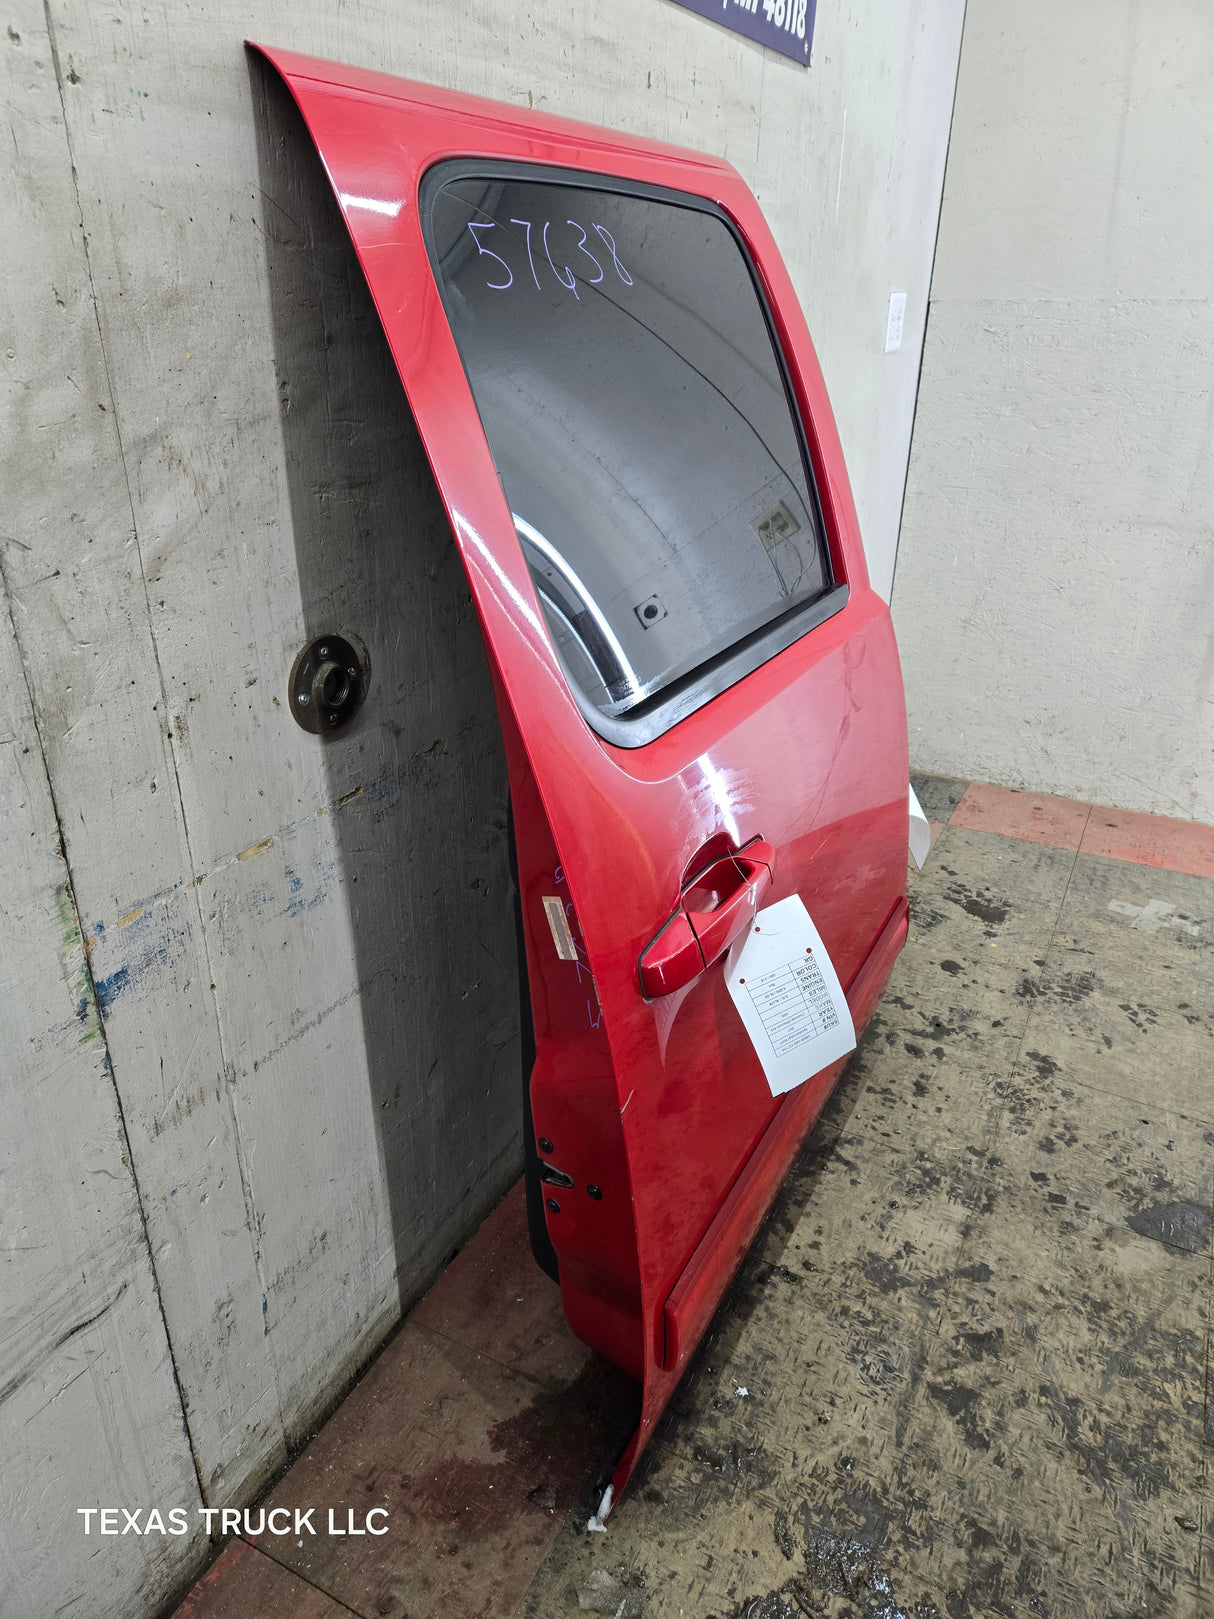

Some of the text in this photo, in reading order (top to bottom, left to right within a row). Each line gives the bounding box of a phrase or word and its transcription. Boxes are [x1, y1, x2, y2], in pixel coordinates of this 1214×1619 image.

[762, 0, 808, 39] 48118
[467, 218, 634, 300] 57638
[795, 962, 816, 976] COLOR
[799, 970, 819, 983] TRANS
[800, 976, 822, 991] ENGINE
[808, 984, 825, 996] MILES
[807, 991, 828, 1005] MODEL
[817, 1005, 833, 1016] YEAR
